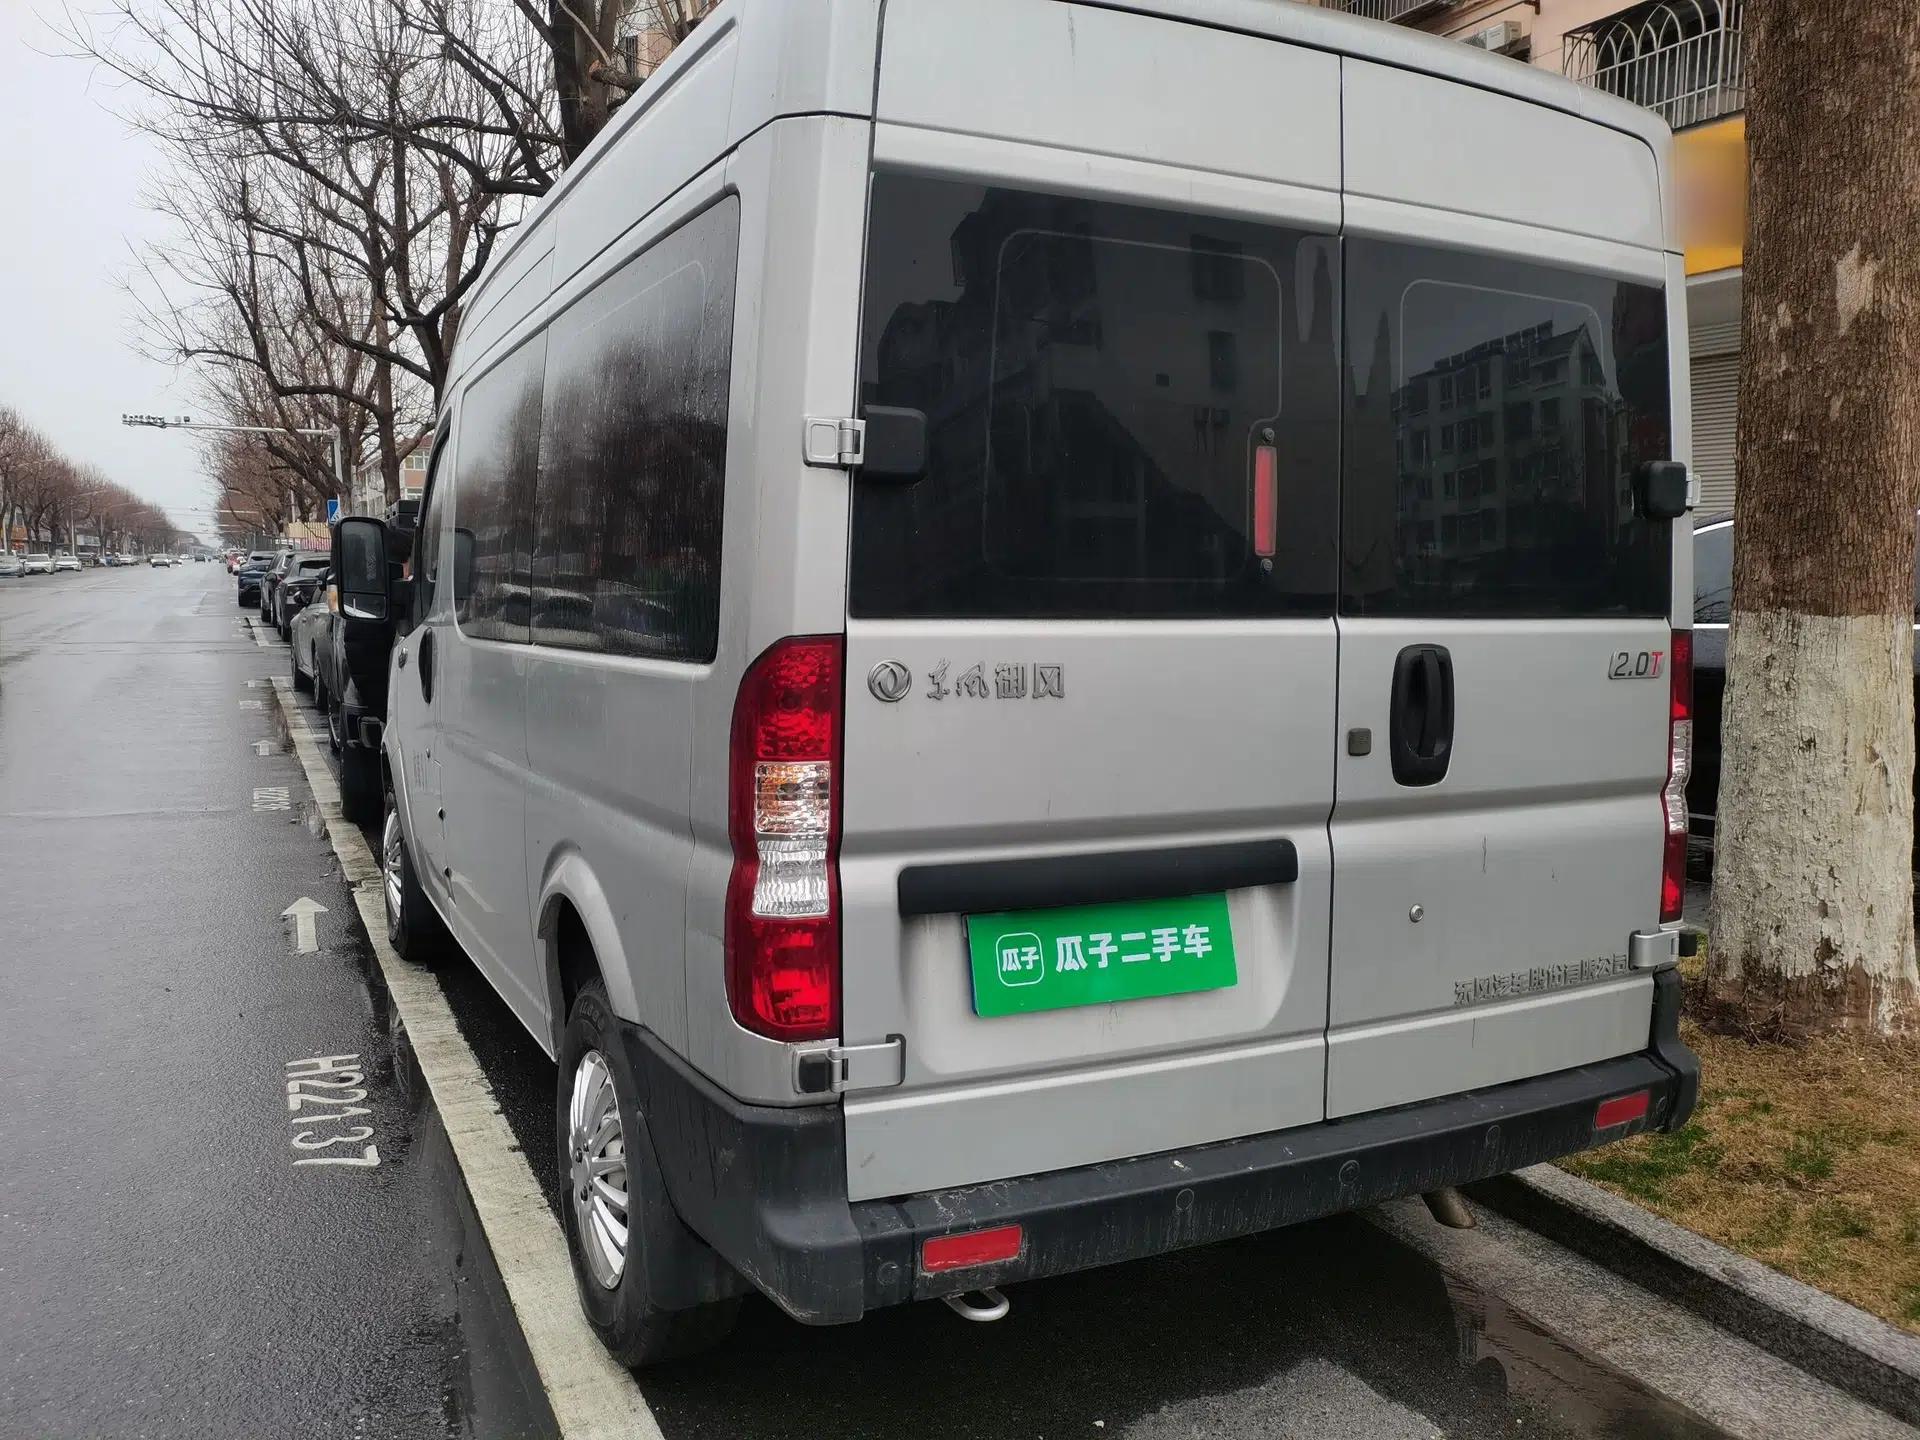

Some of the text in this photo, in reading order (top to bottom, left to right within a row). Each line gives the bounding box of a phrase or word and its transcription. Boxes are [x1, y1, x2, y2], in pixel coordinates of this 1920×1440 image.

[1613, 651, 1664, 677] 2.0T
[1001, 924, 1213, 973] 瓜子 瓜子二手车
[284, 1053, 382, 1167] H22137
